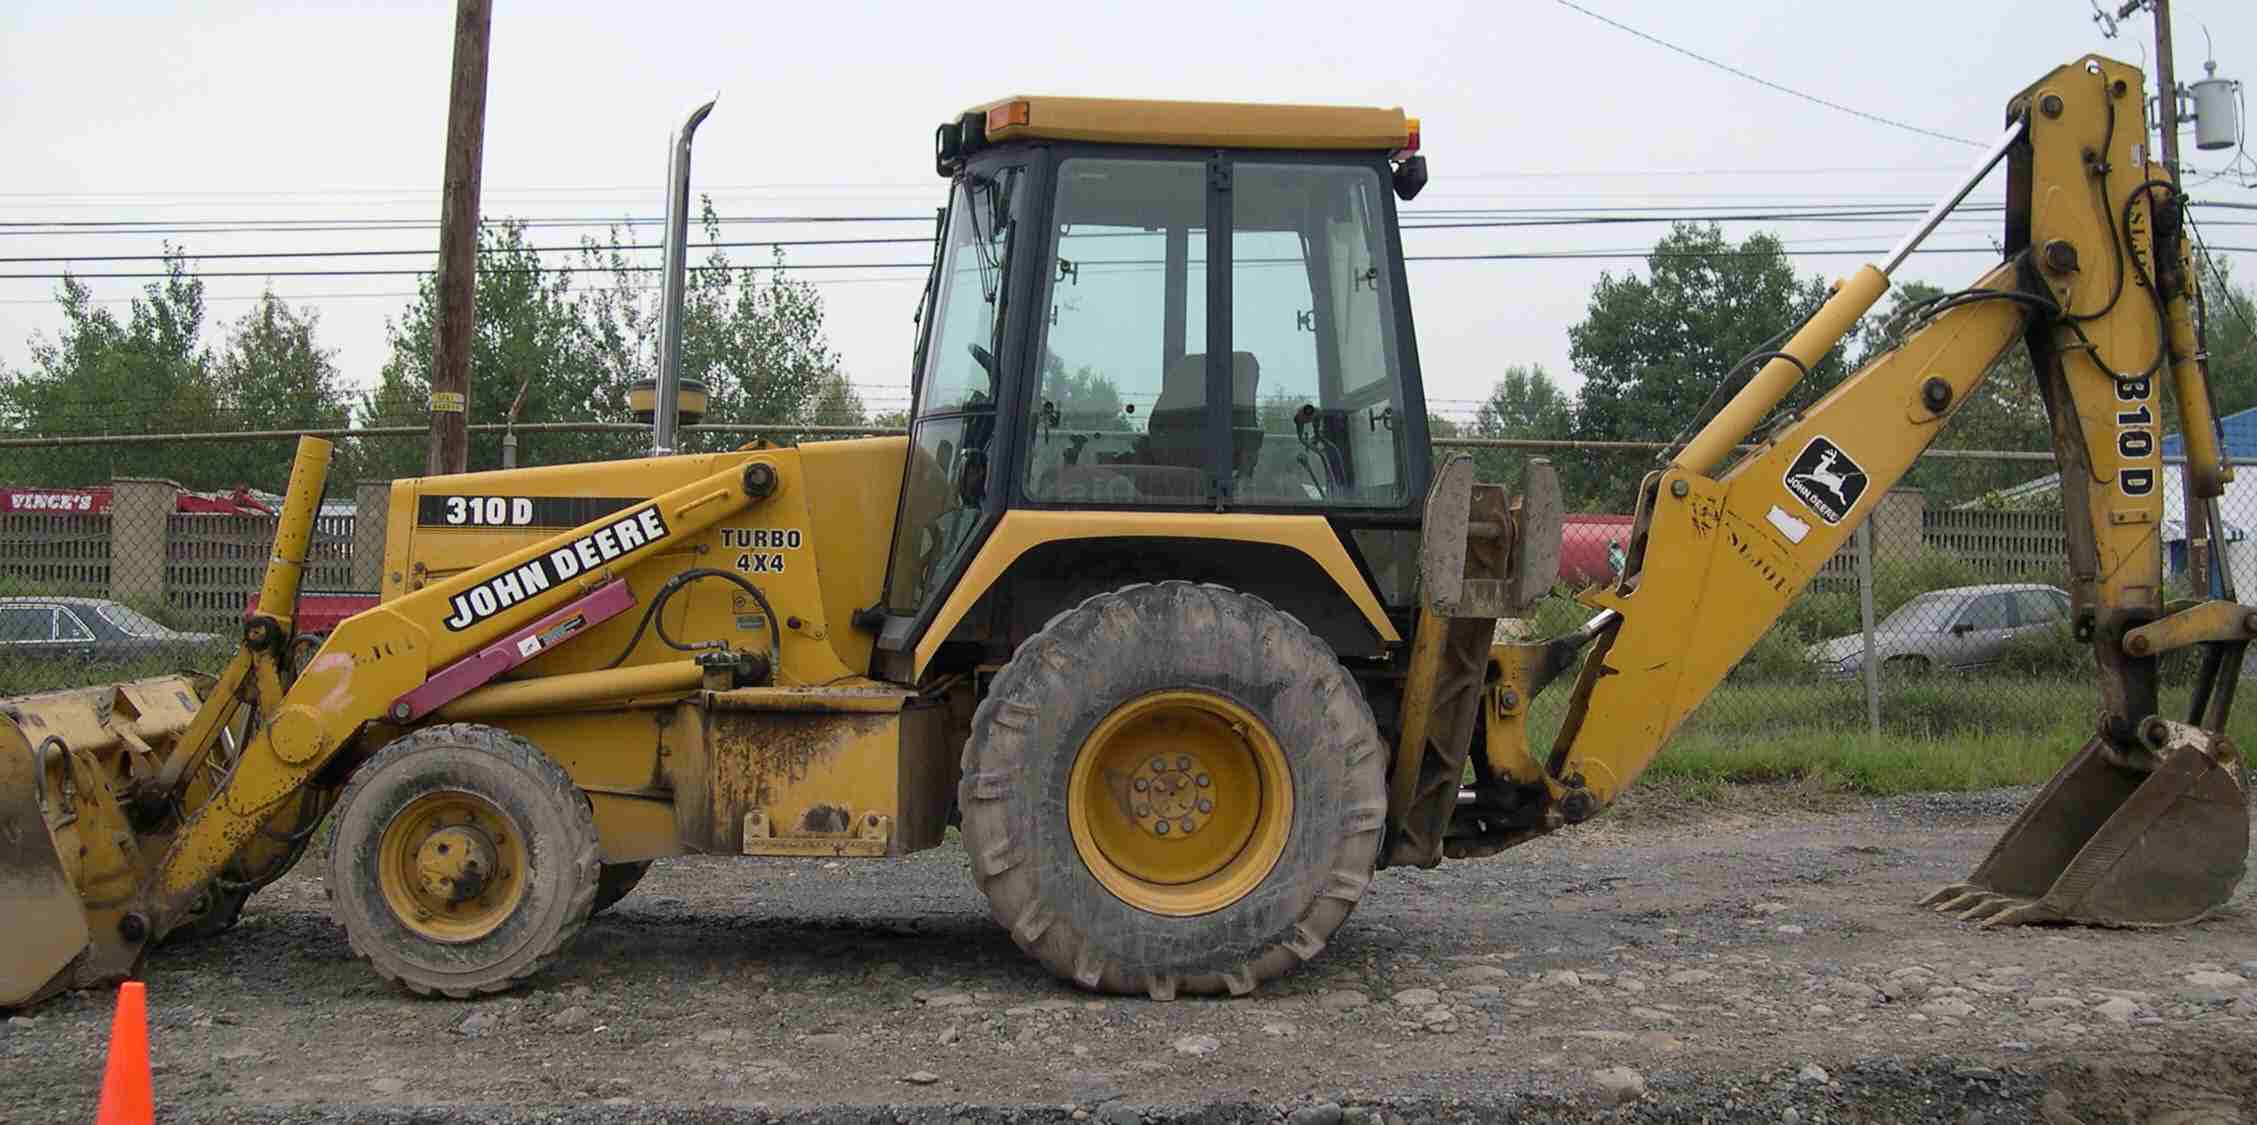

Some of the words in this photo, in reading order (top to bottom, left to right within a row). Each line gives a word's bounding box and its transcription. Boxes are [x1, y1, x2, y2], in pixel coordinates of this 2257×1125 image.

[2119, 467, 2155, 496] D
[11, 494, 92, 510] VINCE'S
[446, 496, 506, 524] 310
[512, 498, 533, 524] D
[1787, 477, 1811, 498] JOHN
[1809, 494, 1841, 521] DEERE
[721, 528, 802, 549] TURBO
[450, 561, 549, 629] JOHN
[551, 508, 664, 571] DEERE
